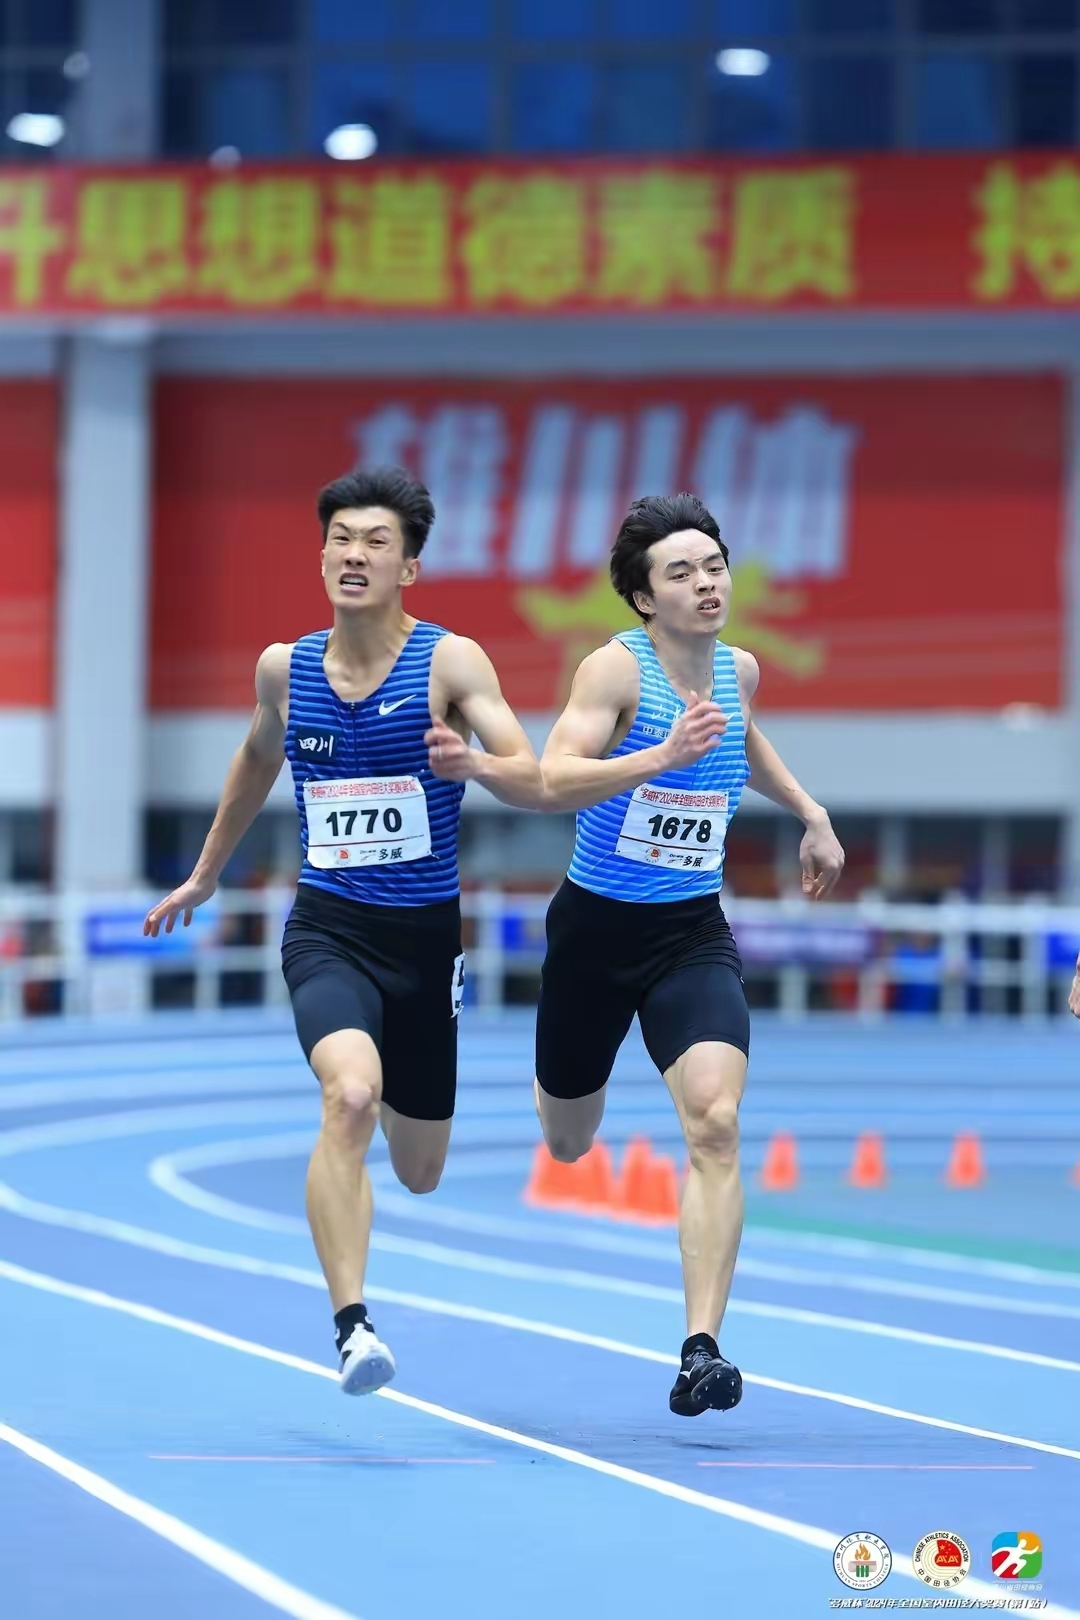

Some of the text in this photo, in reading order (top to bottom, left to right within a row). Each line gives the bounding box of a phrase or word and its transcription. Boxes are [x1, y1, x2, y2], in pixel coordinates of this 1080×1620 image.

[298, 734, 335, 757] 四川
[325, 807, 403, 837] 1770
[647, 813, 712, 844] 1678
[378, 847, 404, 861] 多威
[682, 855, 704, 868] 多威
